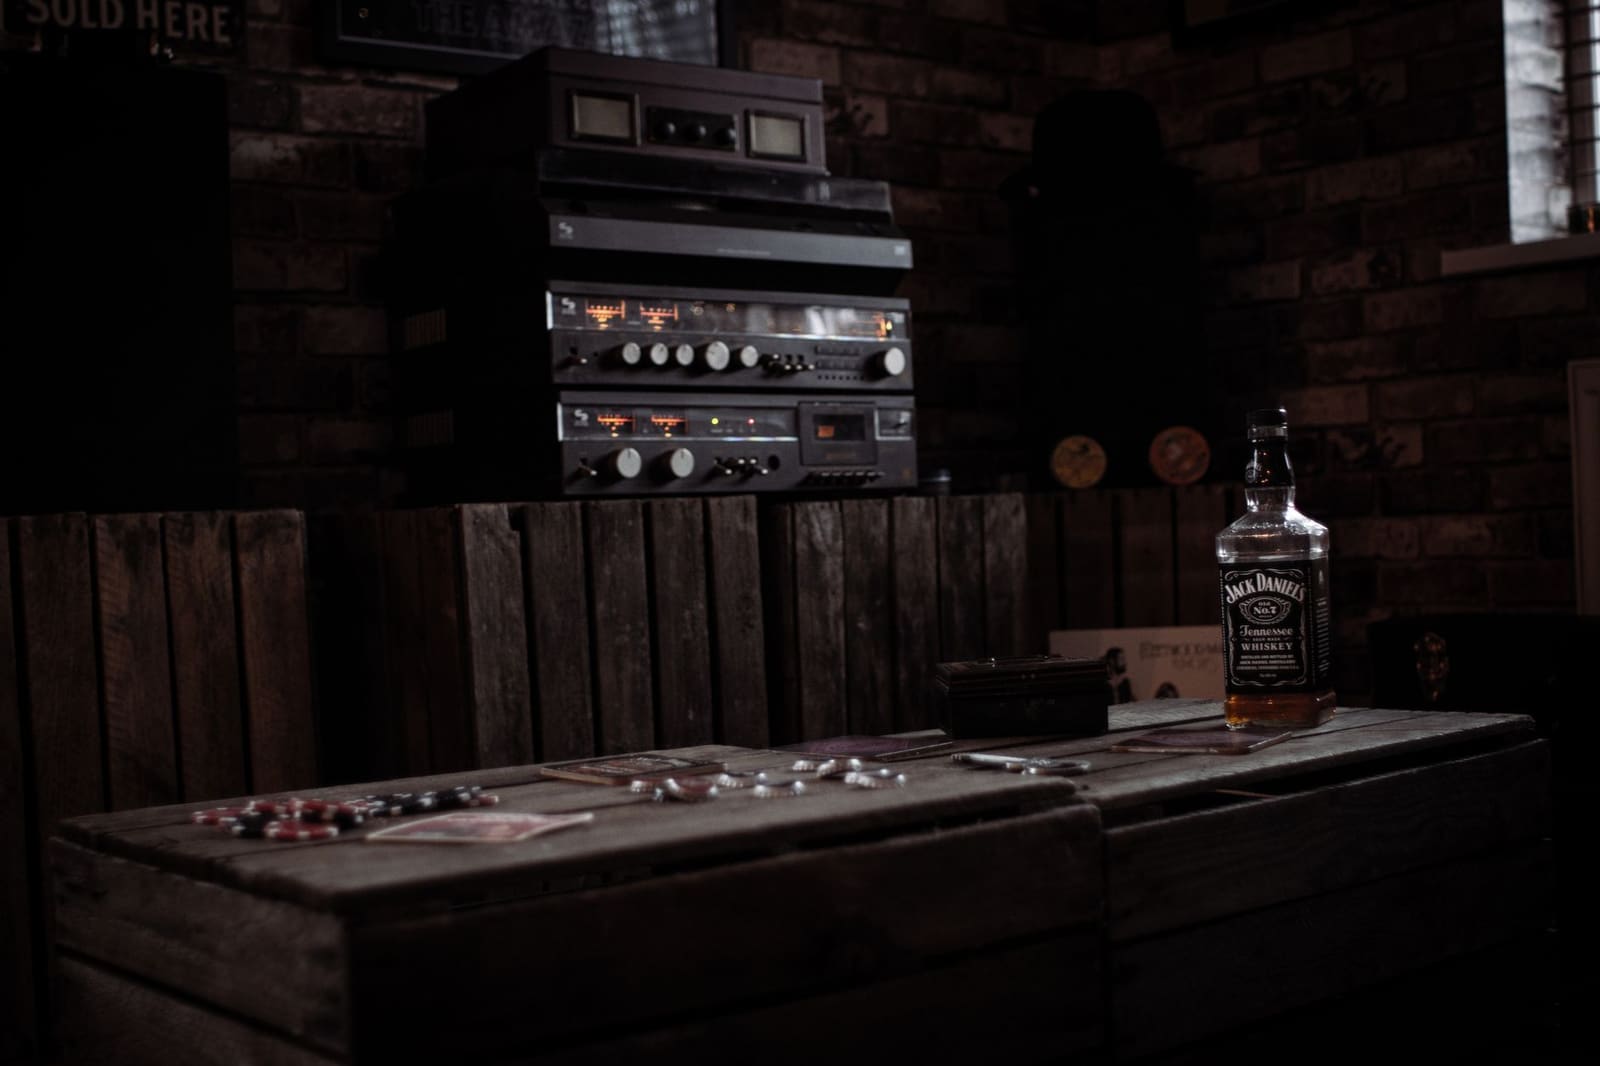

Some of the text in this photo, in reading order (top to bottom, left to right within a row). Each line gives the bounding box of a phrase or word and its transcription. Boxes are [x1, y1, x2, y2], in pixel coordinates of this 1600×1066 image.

[25, 0, 233, 44] SOLD HERE
[1224, 572, 1307, 604] JACK DANIEL'S
[1239, 624, 1294, 637] Tennessee
[1241, 642, 1293, 651] WHISKEY
